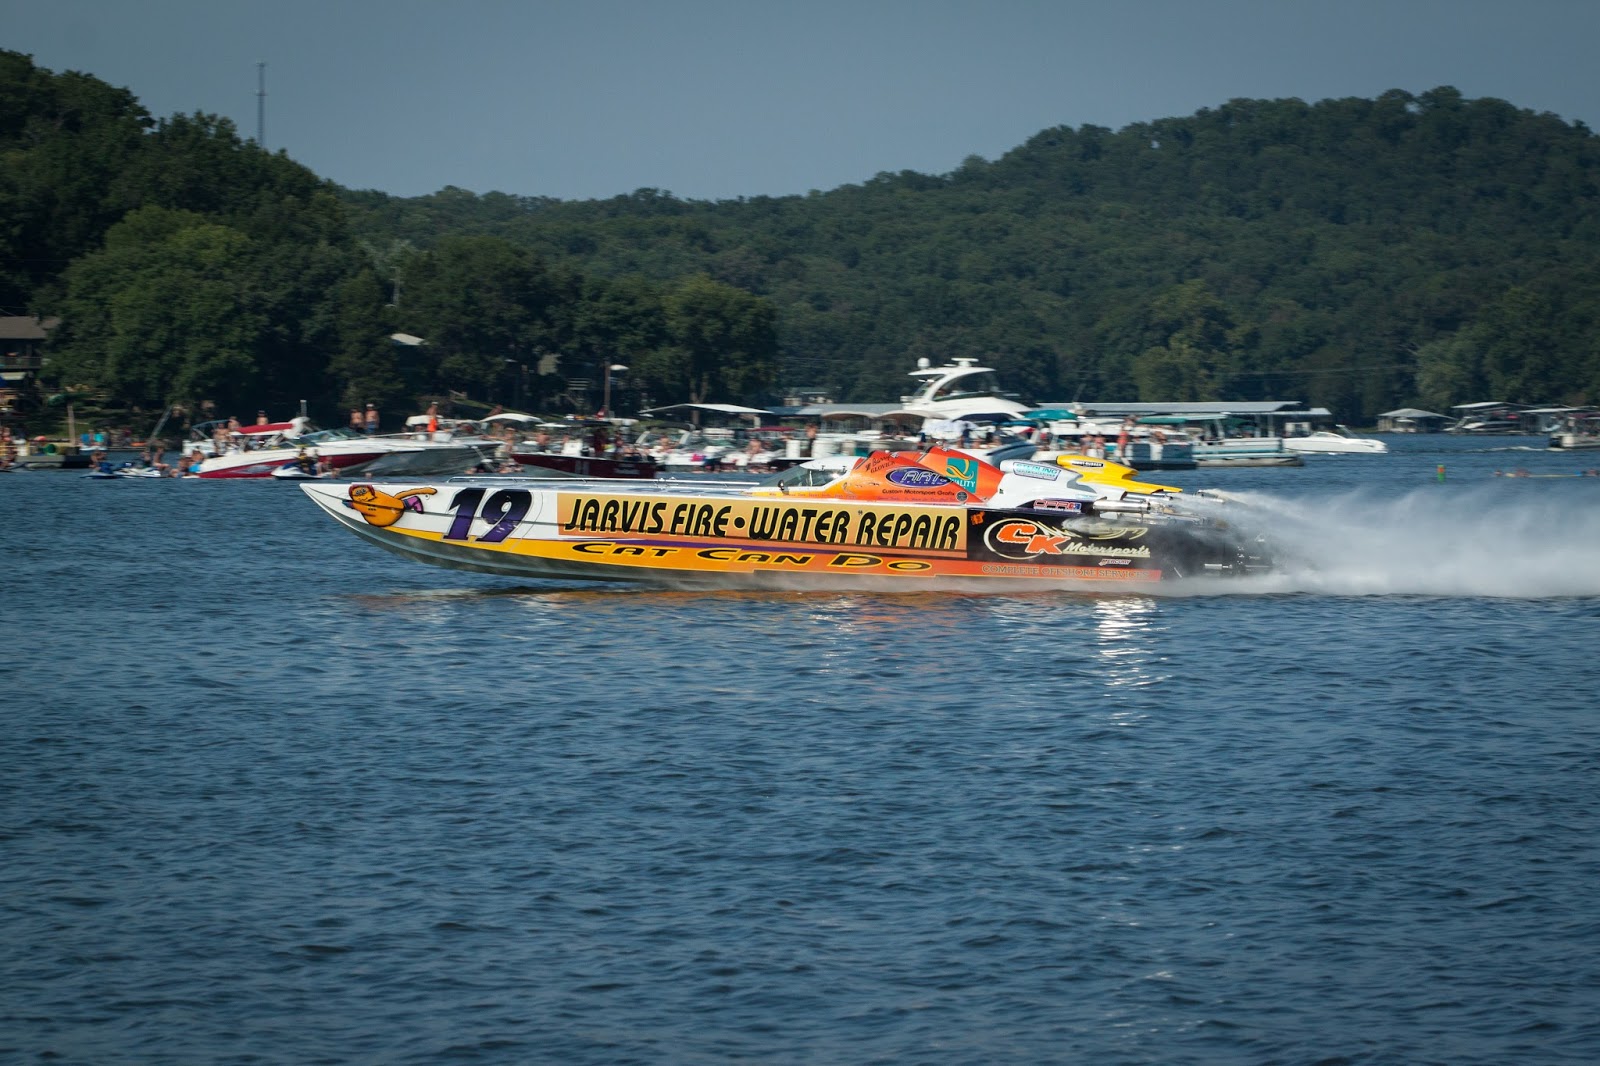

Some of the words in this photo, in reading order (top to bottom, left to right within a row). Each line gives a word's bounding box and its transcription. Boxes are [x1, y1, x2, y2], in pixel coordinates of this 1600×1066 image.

[443, 487, 532, 543] 19
[564, 498, 667, 534] JARVIS
[669, 503, 732, 537] FIRE
[749, 506, 851, 544] WATER
[855, 511, 961, 550] REPAIR
[996, 523, 1071, 555] CK
[1065, 542, 1151, 557] Motorsports
[982, 565, 1039, 575] COMPLETE
[1041, 567, 1097, 578] OFFSHORE
[1098, 569, 1149, 579] SERVICES
